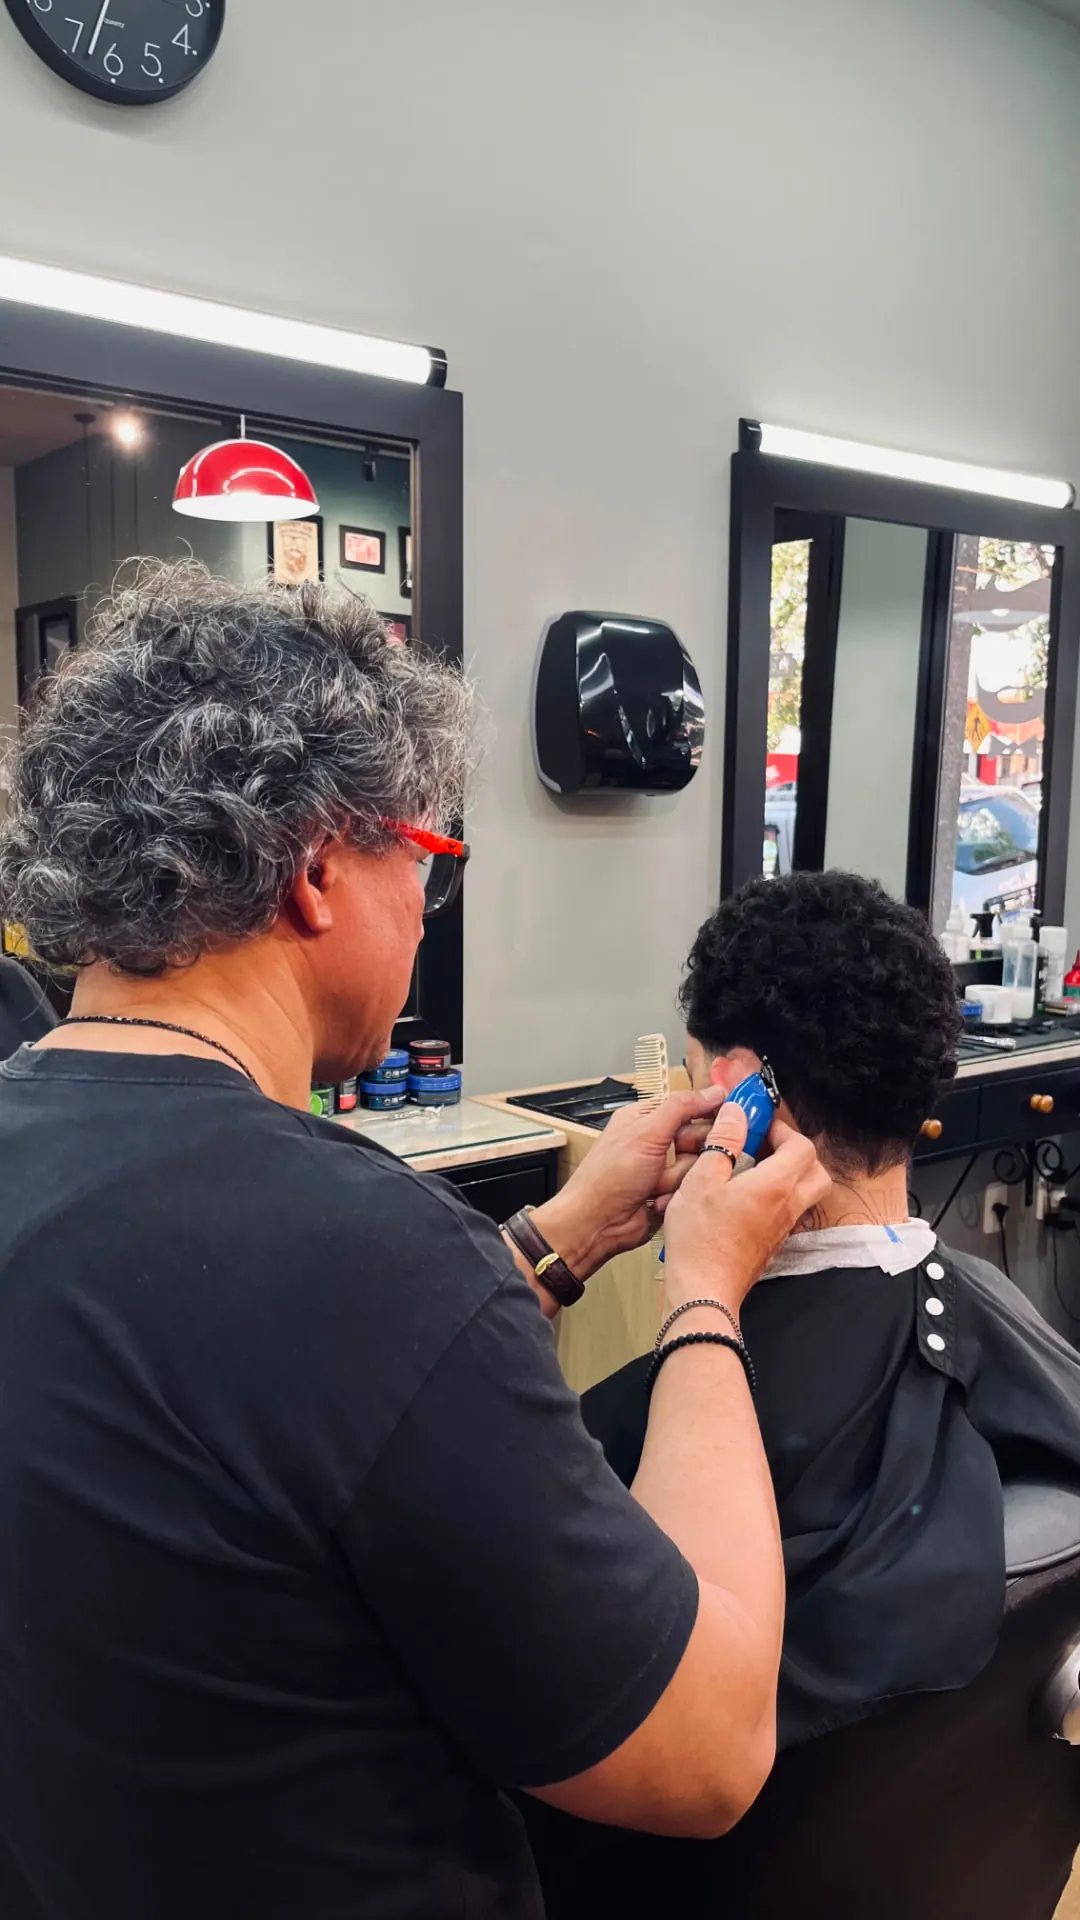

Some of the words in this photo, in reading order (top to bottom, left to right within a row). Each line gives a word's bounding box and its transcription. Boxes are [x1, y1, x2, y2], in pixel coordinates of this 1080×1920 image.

[64, 17, 84, 53] 7
[171, 24, 192, 55] 4
[103, 42, 124, 76] 6
[141, 42, 162, 77] 5
